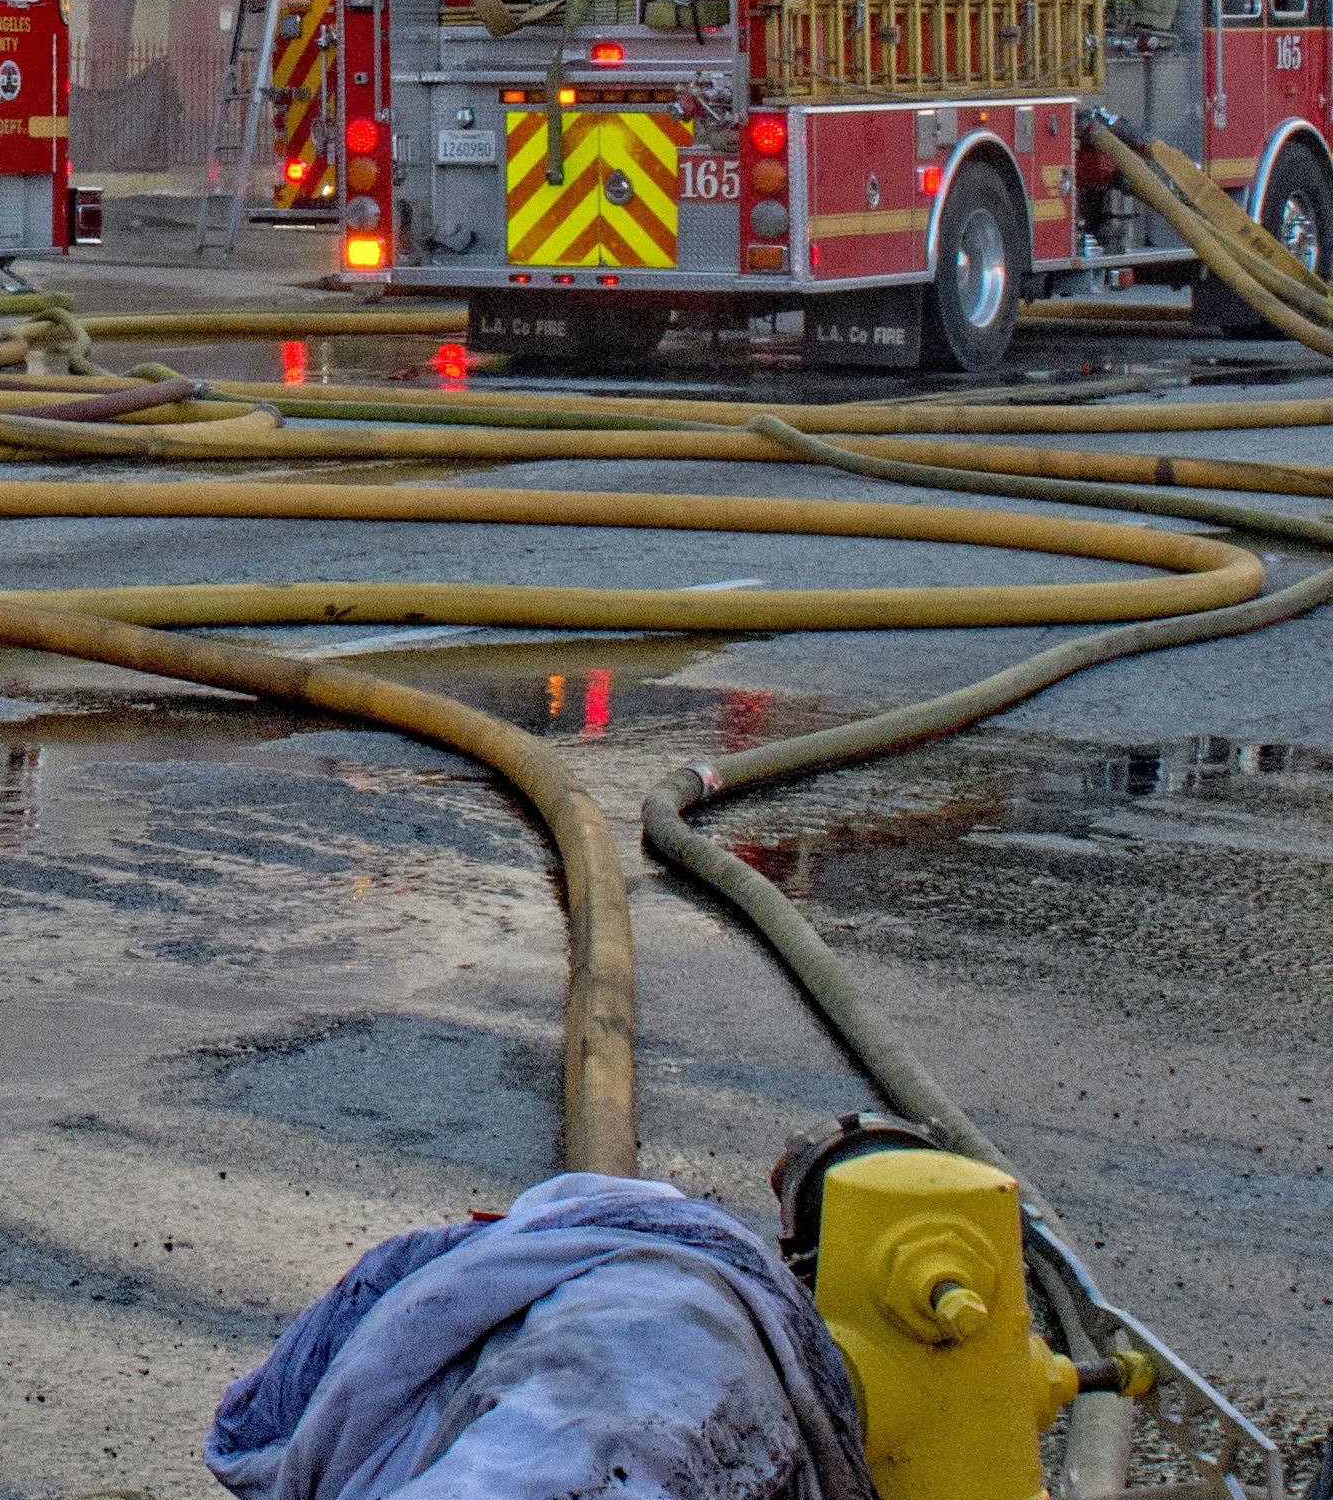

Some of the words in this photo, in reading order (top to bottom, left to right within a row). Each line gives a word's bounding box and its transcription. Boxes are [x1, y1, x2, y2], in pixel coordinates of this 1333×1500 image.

[1275, 35, 1302, 70] 165
[678, 160, 741, 199] 165
[536, 319, 566, 336] FIRE
[874, 326, 906, 345] FIRE
